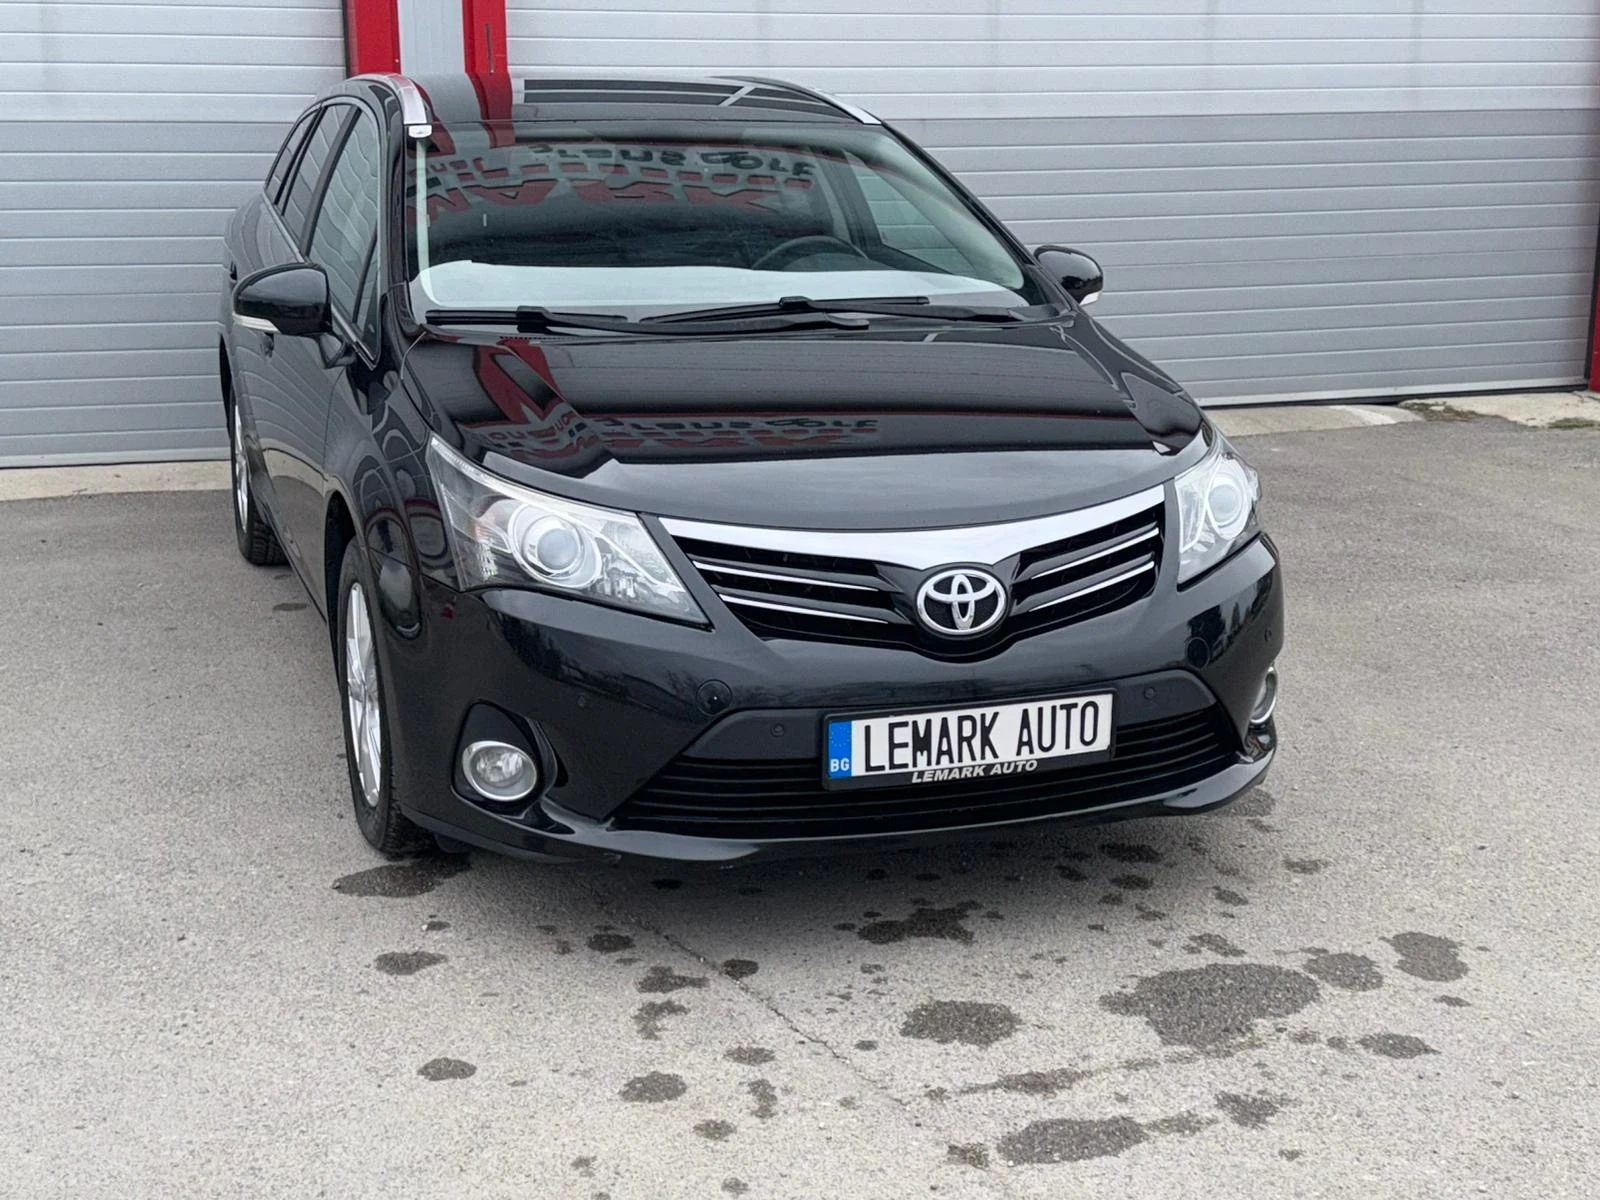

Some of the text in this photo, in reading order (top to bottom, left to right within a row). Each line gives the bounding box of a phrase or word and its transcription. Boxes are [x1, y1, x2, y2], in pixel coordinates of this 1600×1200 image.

[864, 701, 1099, 773] LEMARK AUTO
[830, 758, 850, 773] BG
[911, 759, 1038, 784] LEMARK AUTO
